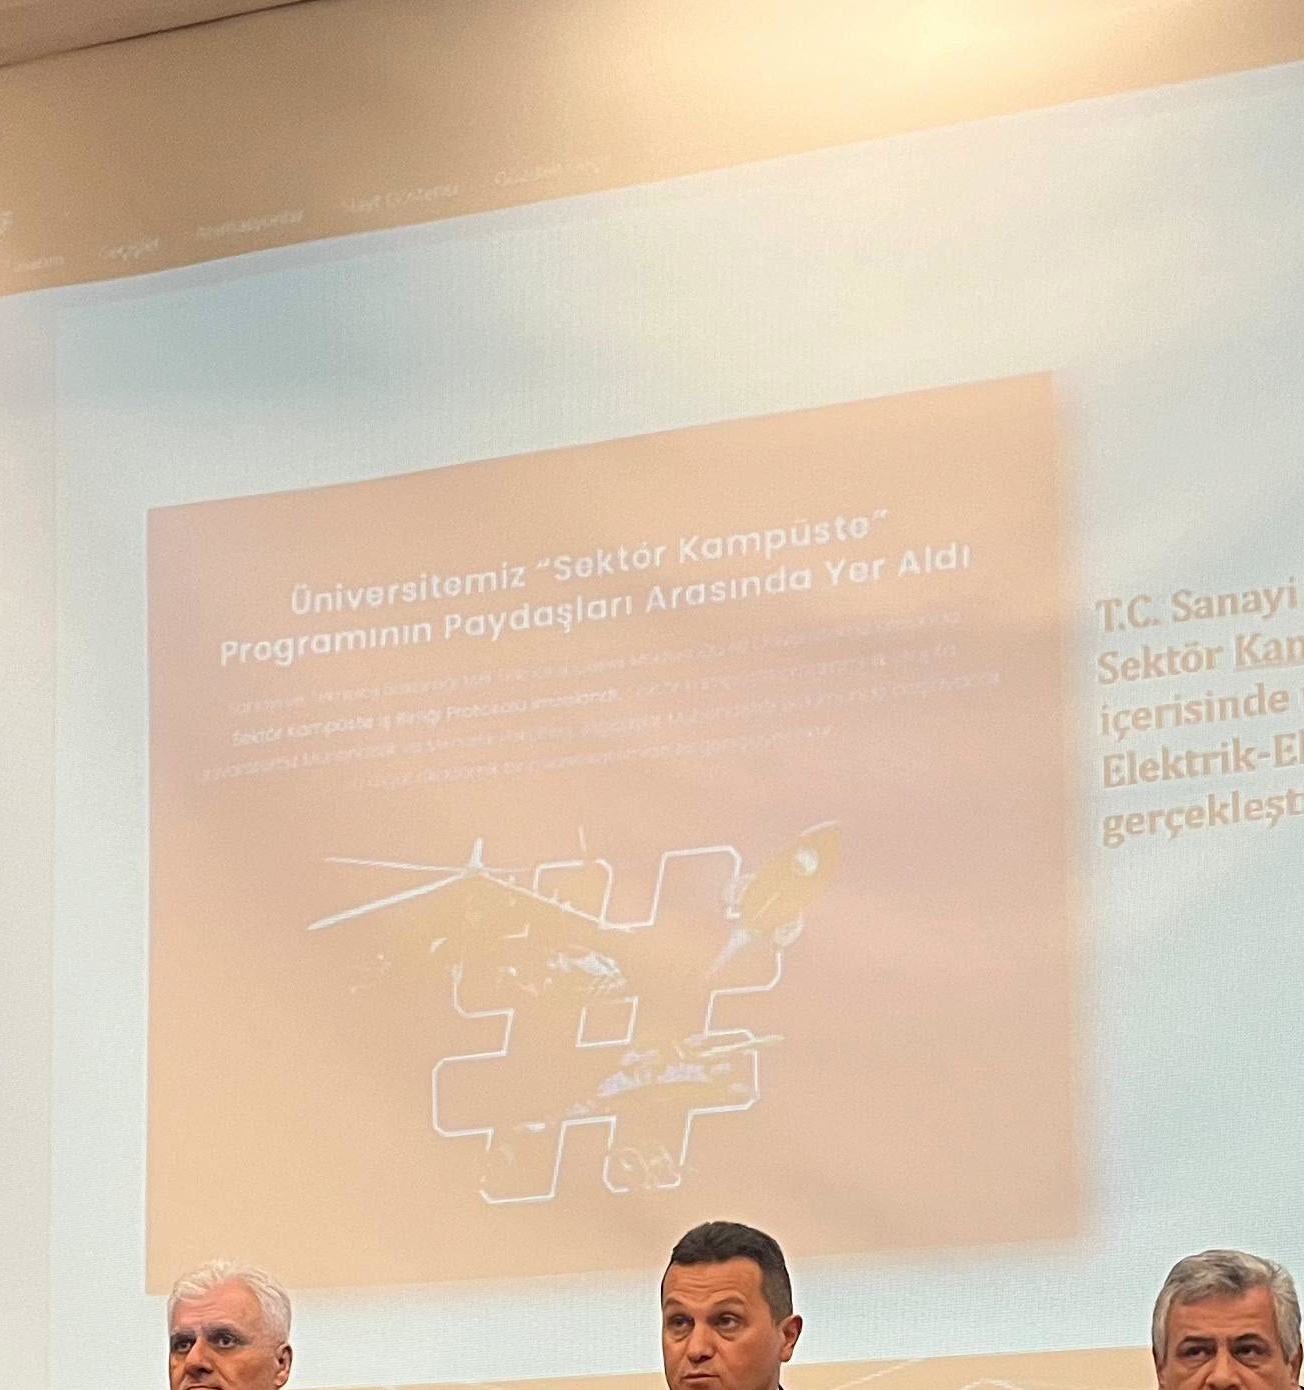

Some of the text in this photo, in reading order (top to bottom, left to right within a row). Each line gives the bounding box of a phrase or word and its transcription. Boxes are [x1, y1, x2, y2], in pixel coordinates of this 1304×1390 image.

[219, 541, 972, 668] Programının Paydaşları Arasında Yer Aldı
[290, 563, 526, 618] Üniversitemiz
[1097, 596, 1160, 633] T.C.
[1171, 577, 1297, 626] Sanayi
[1097, 642, 1223, 685] Sektör
[1100, 680, 1290, 741] içerisinde
